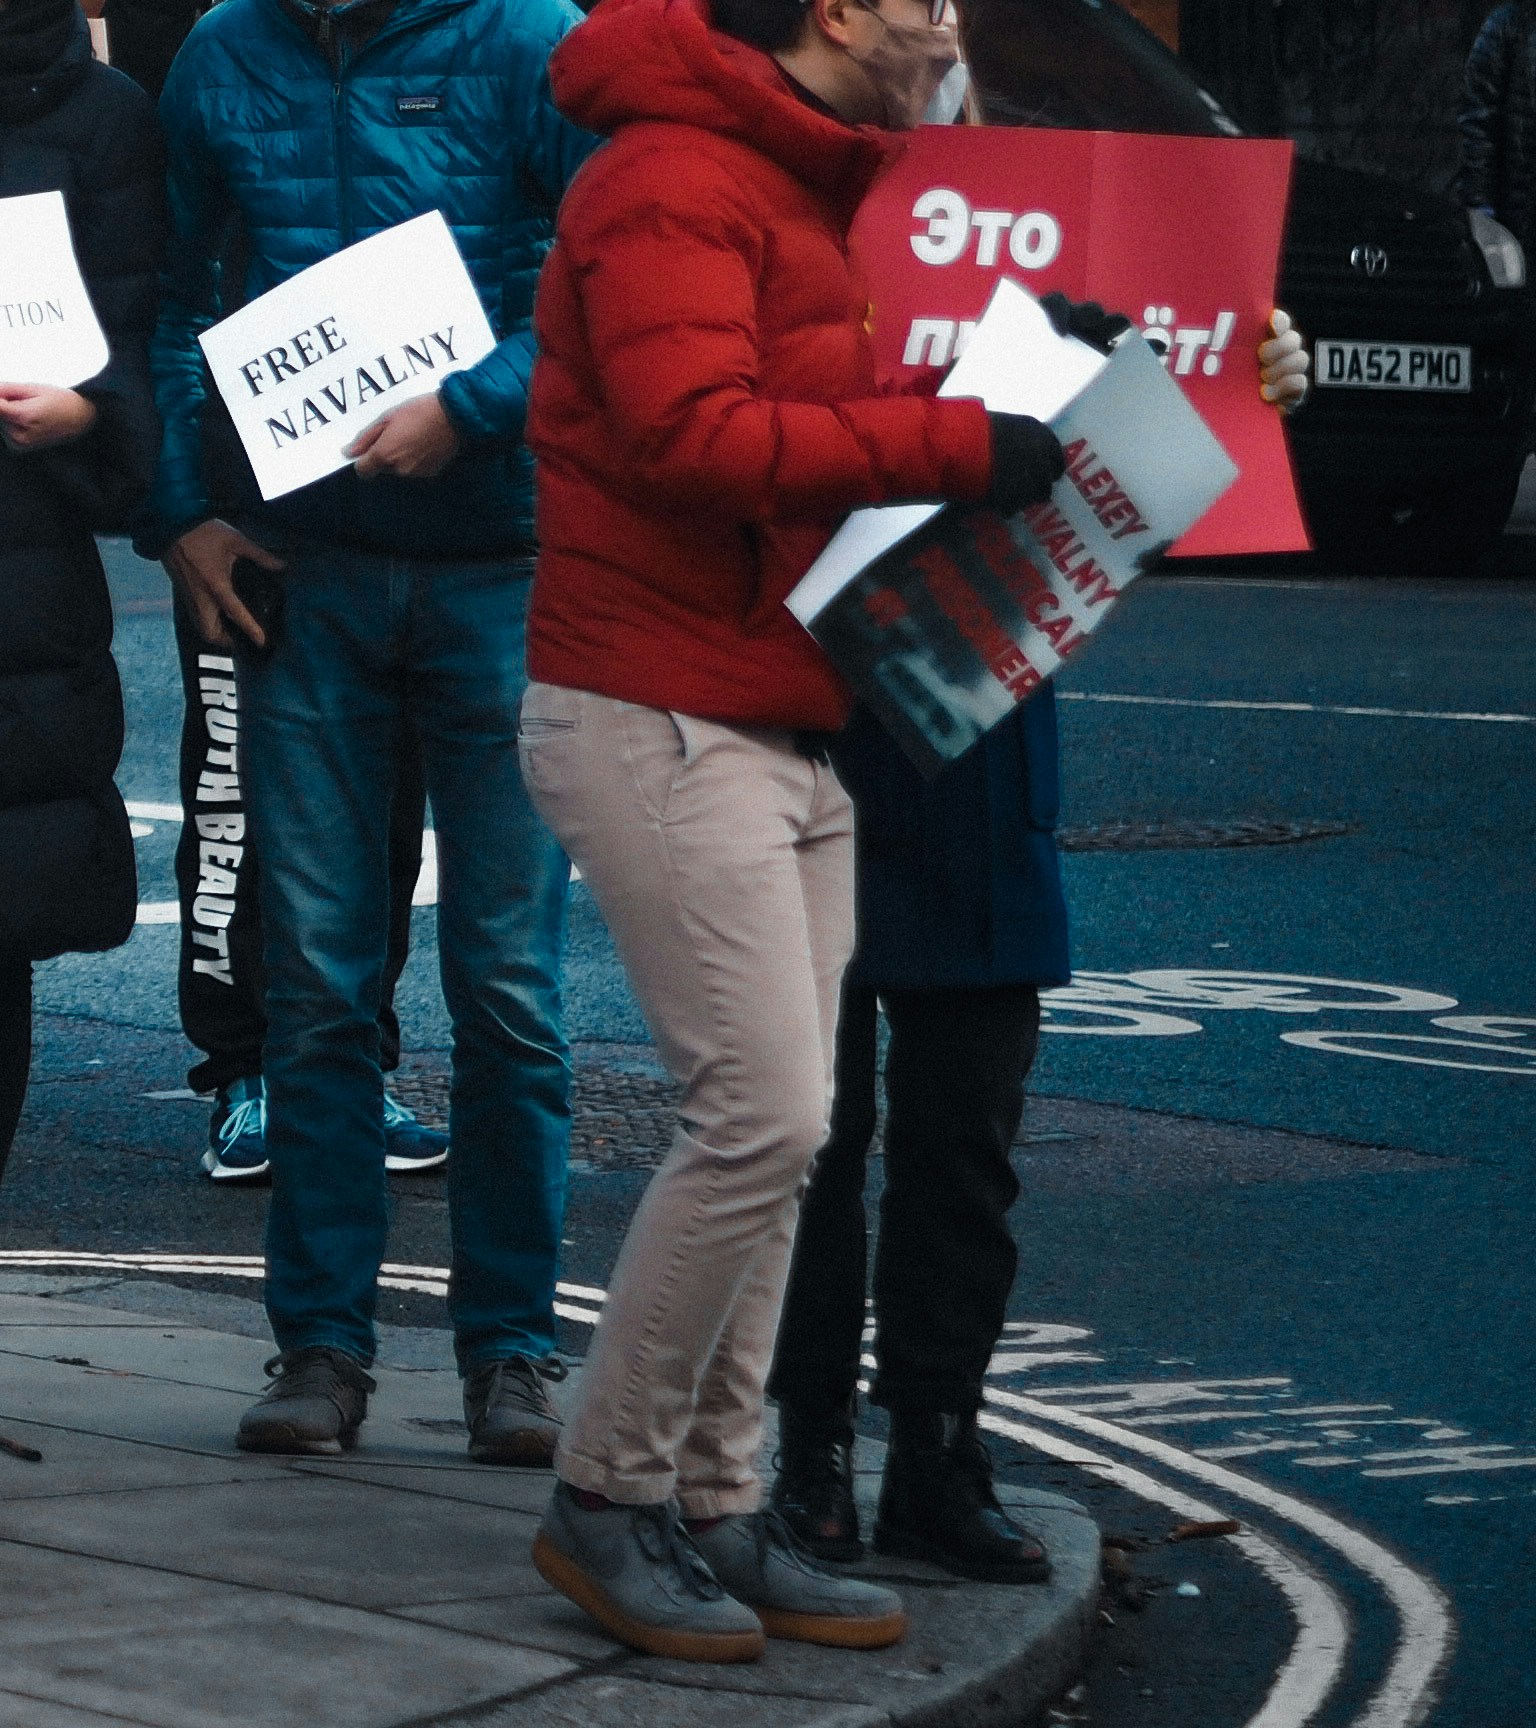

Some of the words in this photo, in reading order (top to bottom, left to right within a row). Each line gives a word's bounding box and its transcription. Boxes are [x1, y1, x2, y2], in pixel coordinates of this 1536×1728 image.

[909, 186, 1063, 270] Это
[237, 315, 349, 399] FREE
[262, 325, 461, 450] NAVALNY
[1328, 346, 1401, 384] DA52
[1062, 437, 1150, 541] ALEXEY
[192, 812, 246, 987] BEAUTY
